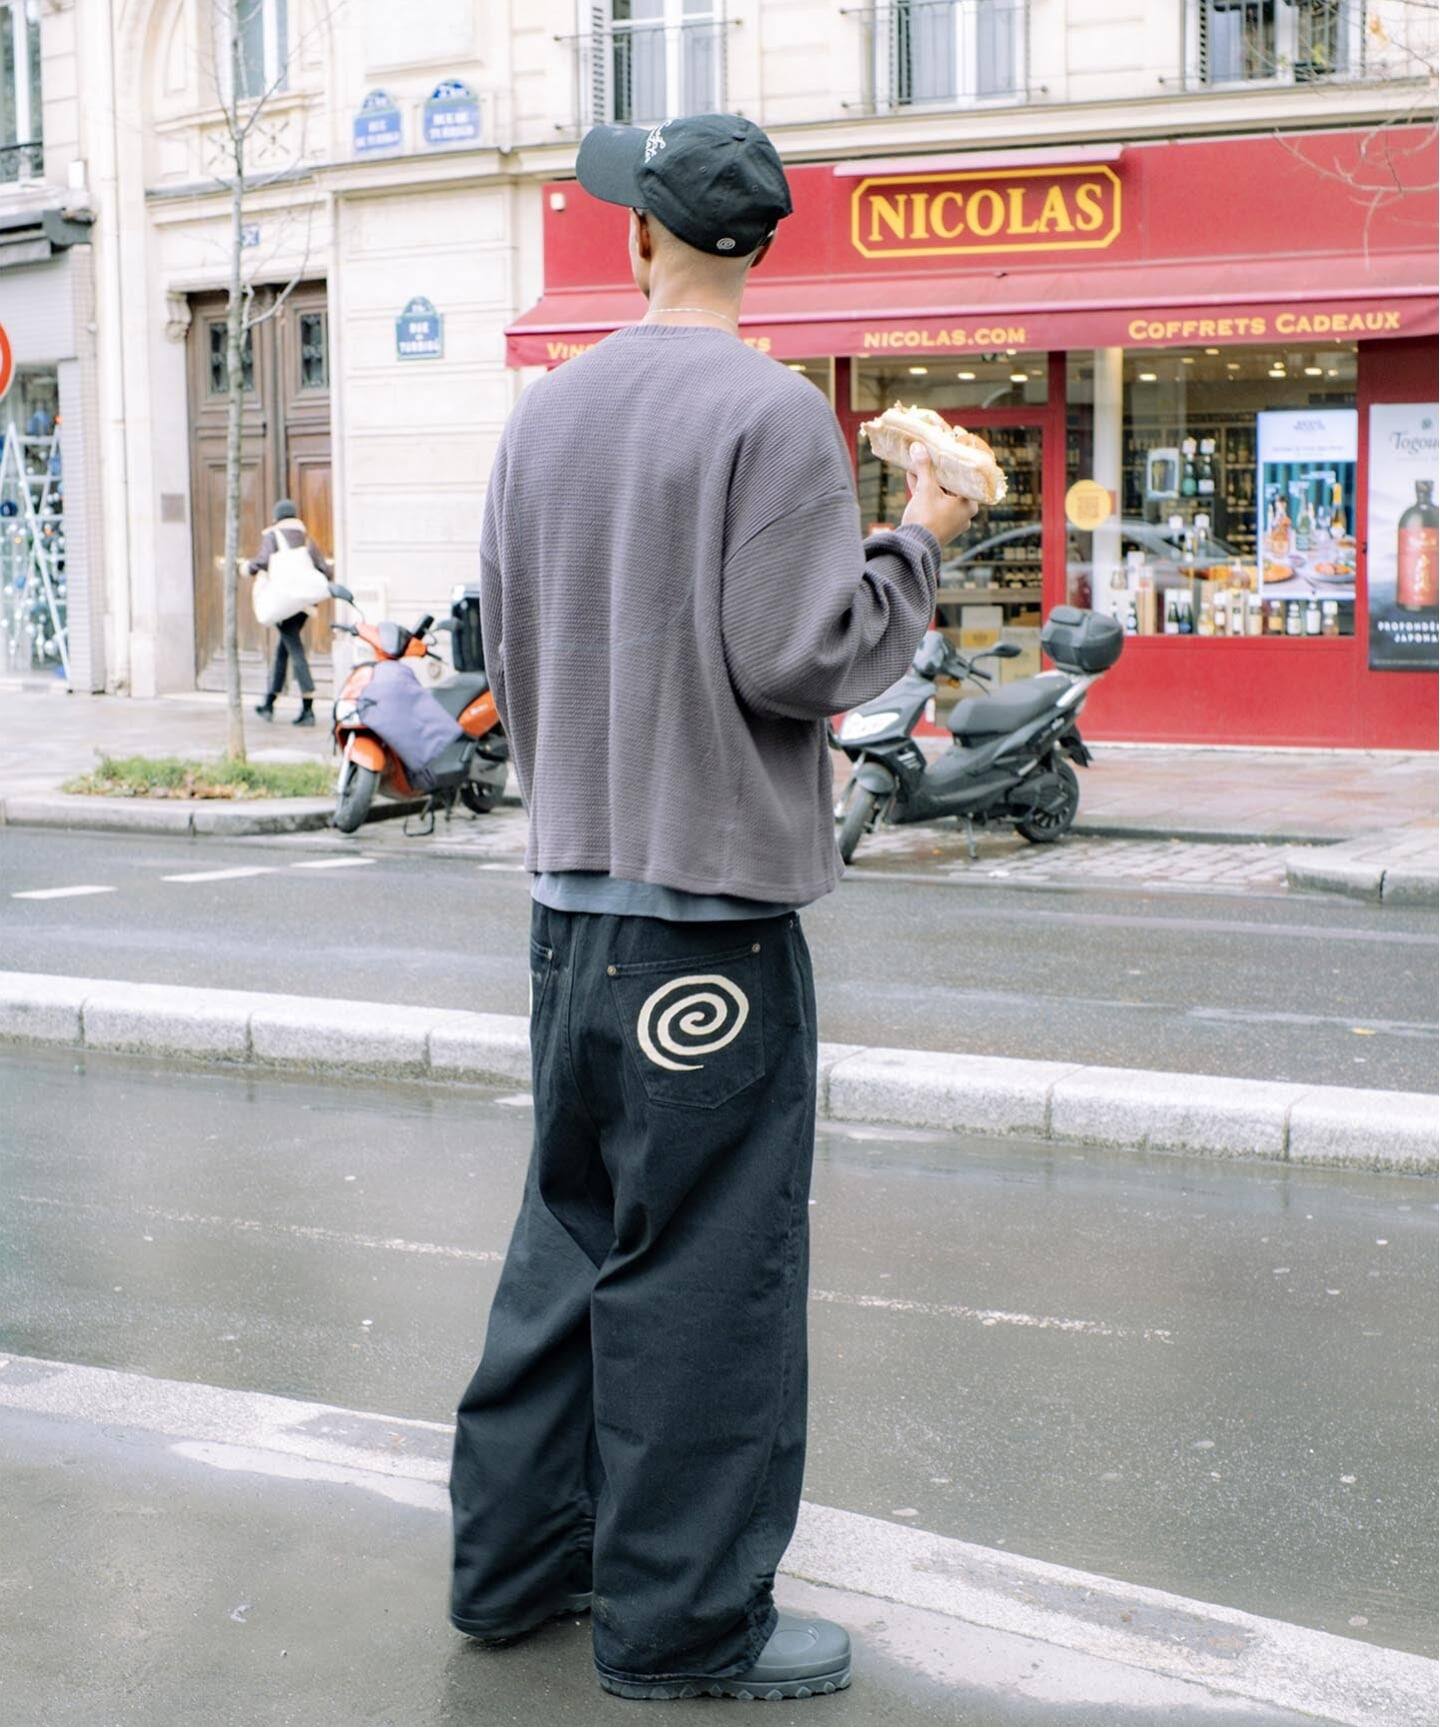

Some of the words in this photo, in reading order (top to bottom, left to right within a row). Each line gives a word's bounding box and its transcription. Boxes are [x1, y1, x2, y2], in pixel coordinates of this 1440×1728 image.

[868, 183, 1104, 242] NICOLAS
[864, 327, 1026, 348] NICOLAS.COM
[1128, 318, 1266, 341] COFFRETS
[1275, 312, 1401, 335] CADEAUX
